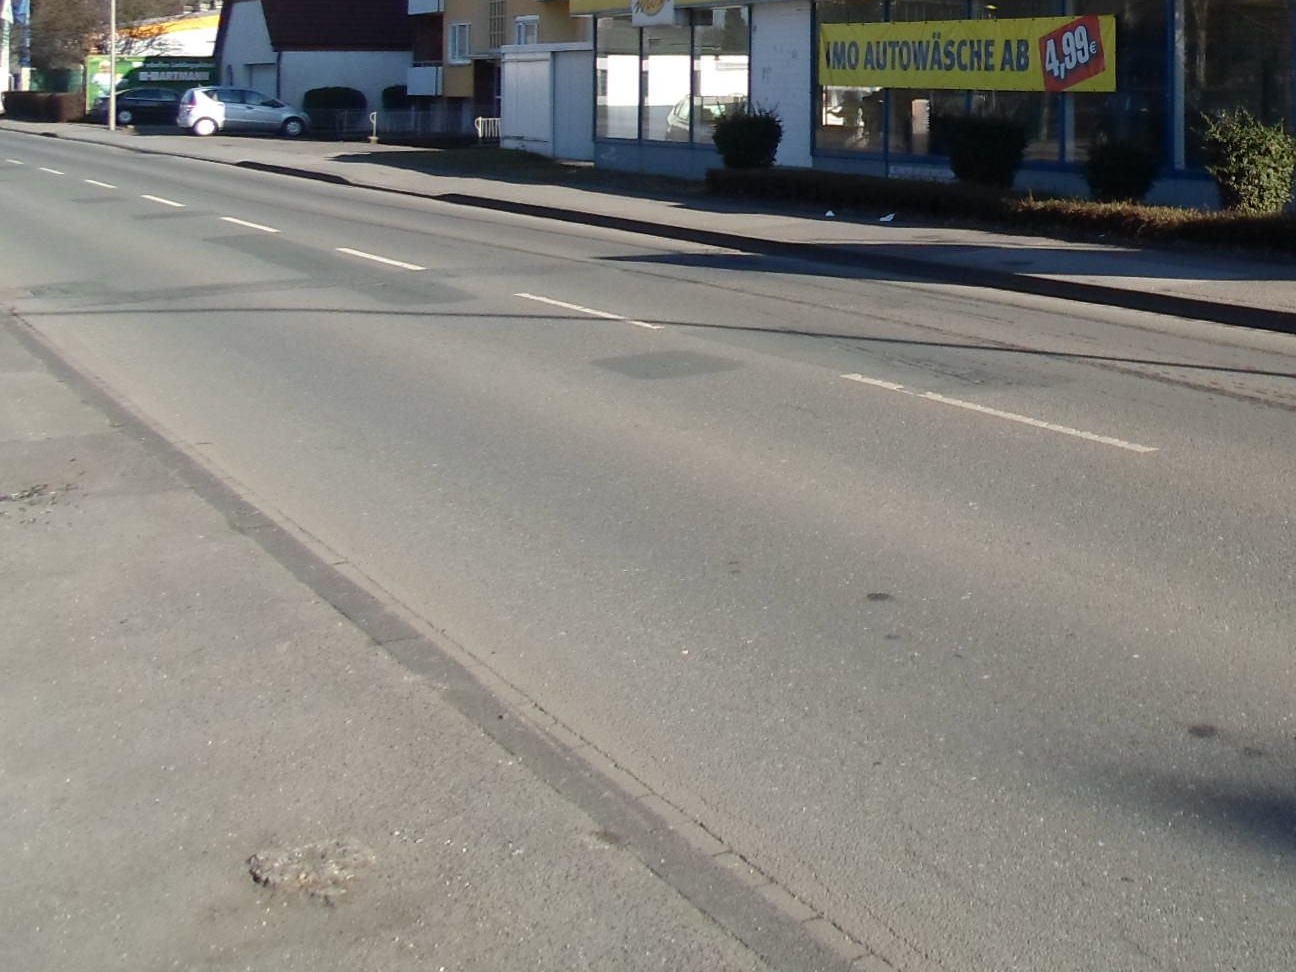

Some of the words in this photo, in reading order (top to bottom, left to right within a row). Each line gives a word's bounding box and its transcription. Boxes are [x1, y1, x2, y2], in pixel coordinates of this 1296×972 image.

[826, 41, 860, 70] IMO
[863, 32, 995, 71] AUTOWÄSCHE
[1001, 38, 1030, 72] AB
